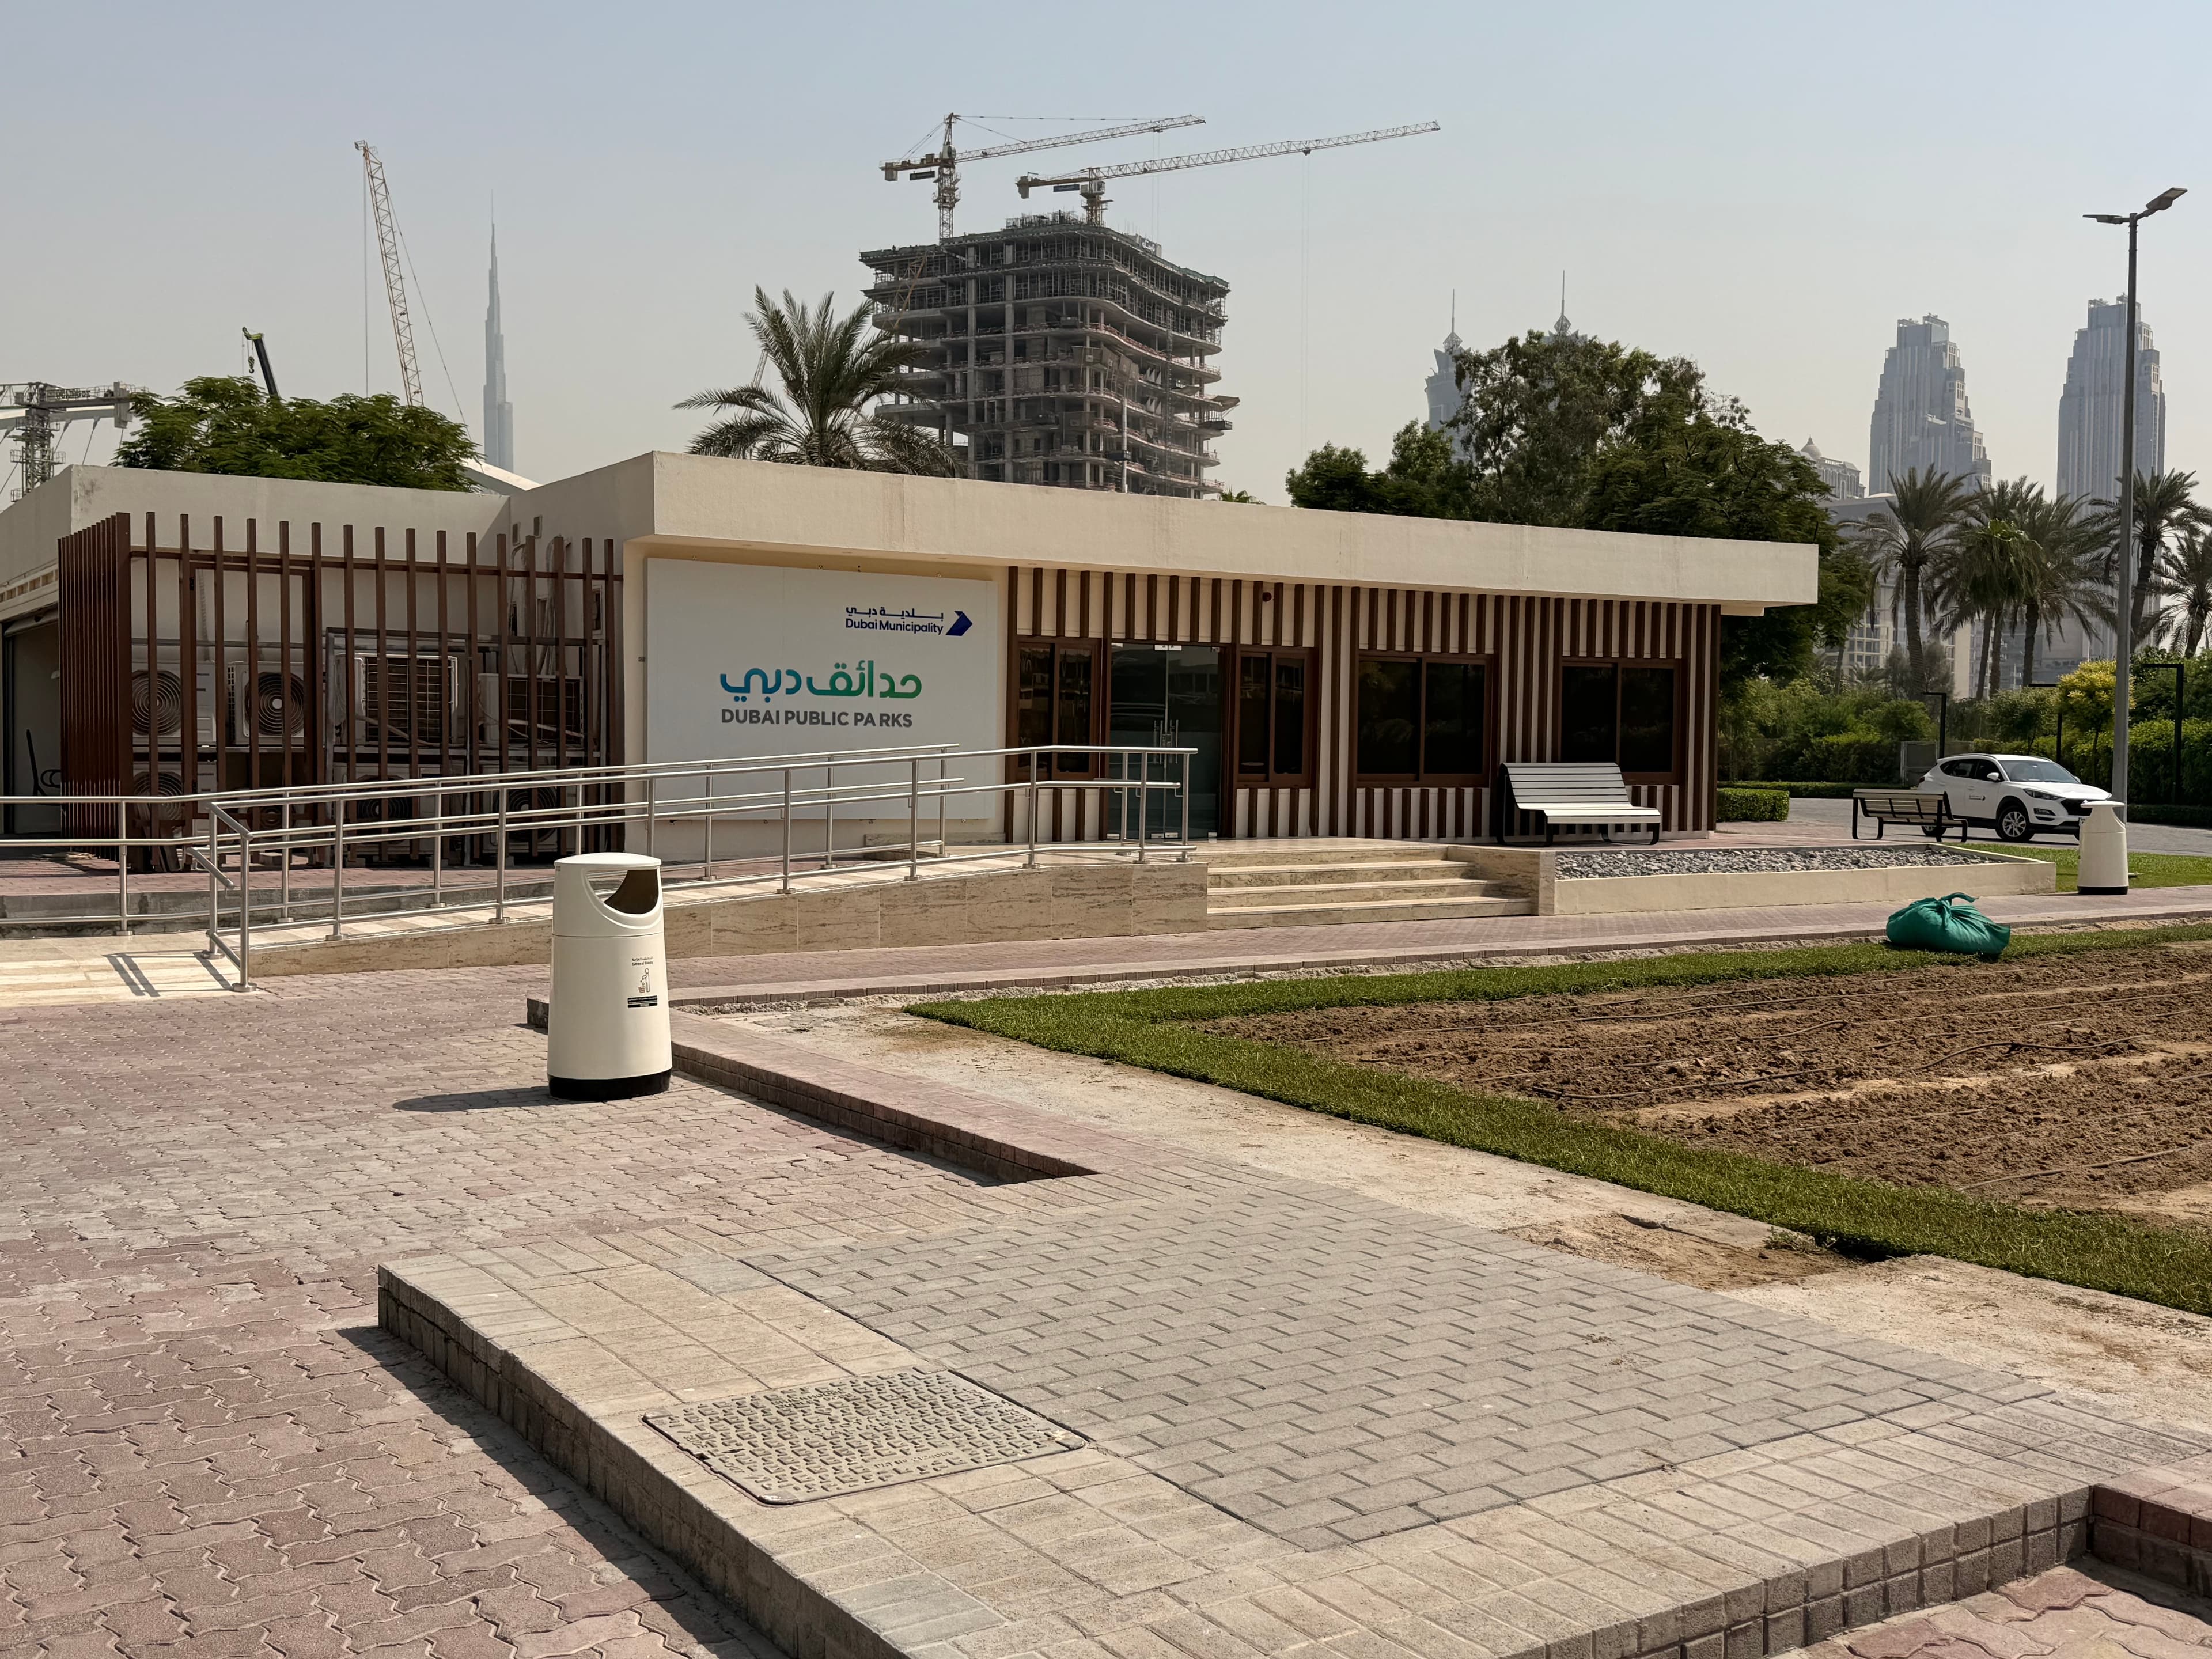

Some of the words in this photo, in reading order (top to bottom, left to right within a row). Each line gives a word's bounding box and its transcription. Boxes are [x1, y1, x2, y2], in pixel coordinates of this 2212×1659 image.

[846, 607, 877, 618] دبي
[879, 607, 944, 622] بلدية
[846, 618, 877, 630] Dubai
[879, 620, 944, 635] Municipality
[720, 668, 802, 703] دبي
[806, 660, 922, 699] حدائق
[721, 709, 780, 724] DUBAI
[785, 710, 849, 726] PUBLIC
